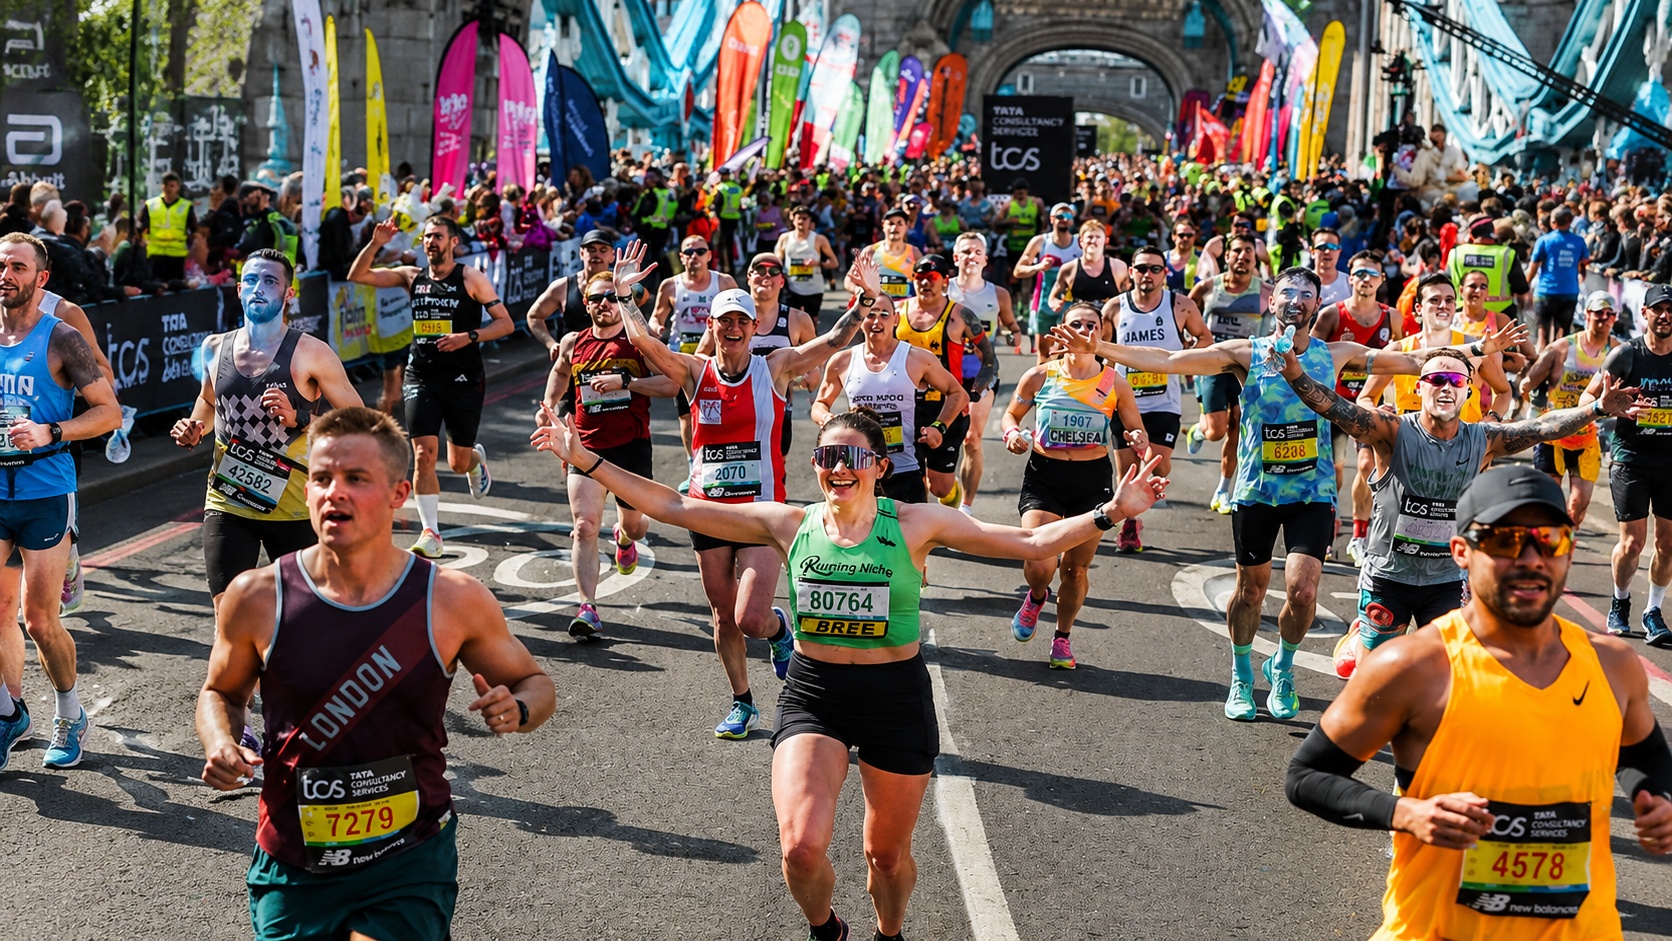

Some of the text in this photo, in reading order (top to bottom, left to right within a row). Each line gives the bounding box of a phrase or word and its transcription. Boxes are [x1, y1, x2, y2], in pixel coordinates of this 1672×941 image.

[992, 106, 1024, 116] TATA
[991, 117, 1065, 127] CONSULTANCY
[990, 141, 1041, 171] tcs
[1124, 328, 1165, 343] JAMES
[1063, 414, 1092, 428] 1907
[1050, 430, 1101, 444] CHELSEA
[1264, 427, 1286, 439] tcs
[715, 465, 746, 480] 2070
[1404, 497, 1428, 515] tcs
[859, 563, 894, 578] Niche
[810, 590, 873, 612] 80764
[815, 620, 876, 635] BREE
[299, 644, 402, 751] LONDON
[349, 770, 374, 780] TATA
[350, 770, 406, 789] CONSULTANCY
[302, 774, 346, 800] tcs
[325, 806, 394, 837] 7279
[1533, 810, 1557, 820] TATA
[1487, 814, 1527, 837] cs
[1531, 818, 1588, 829] CONSULTANCY
[1530, 828, 1568, 838] SERVICES
[1492, 851, 1565, 880] 4578
[1509, 904, 1533, 913] new
